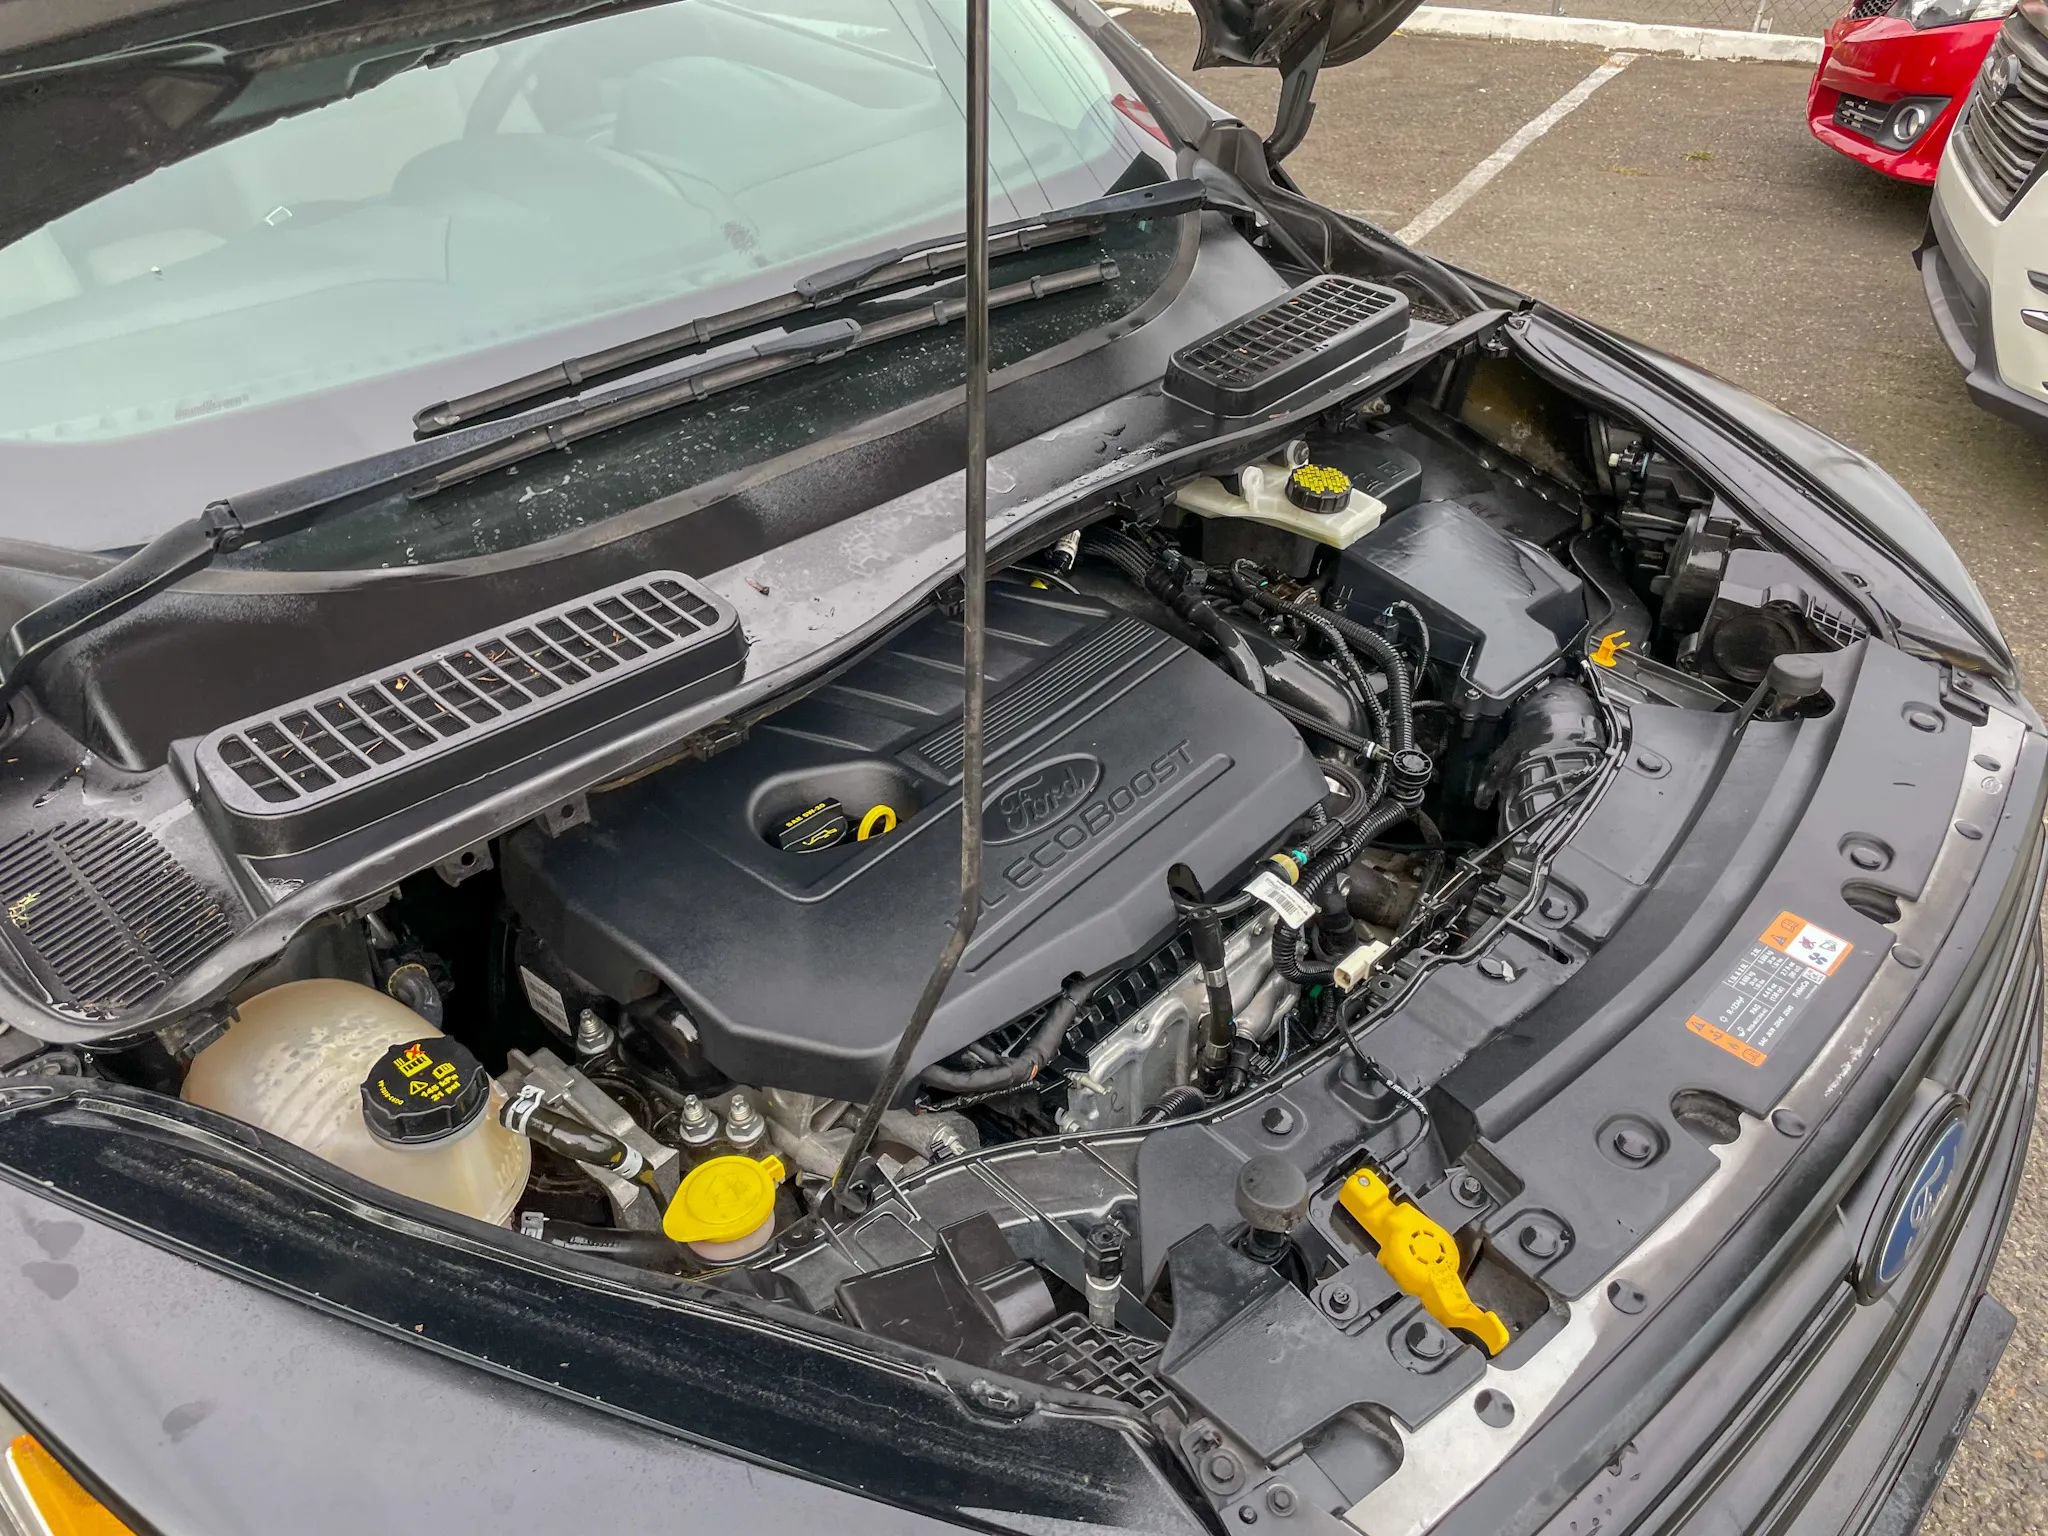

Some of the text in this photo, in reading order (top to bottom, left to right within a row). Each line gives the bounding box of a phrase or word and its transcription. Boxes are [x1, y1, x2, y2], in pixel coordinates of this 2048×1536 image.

[1000, 766, 1086, 834] Ford
[785, 816, 804, 828] SAE
[420, 1074, 459, 1098] 145 kPa
[430, 1081, 461, 1102] 21 psi
